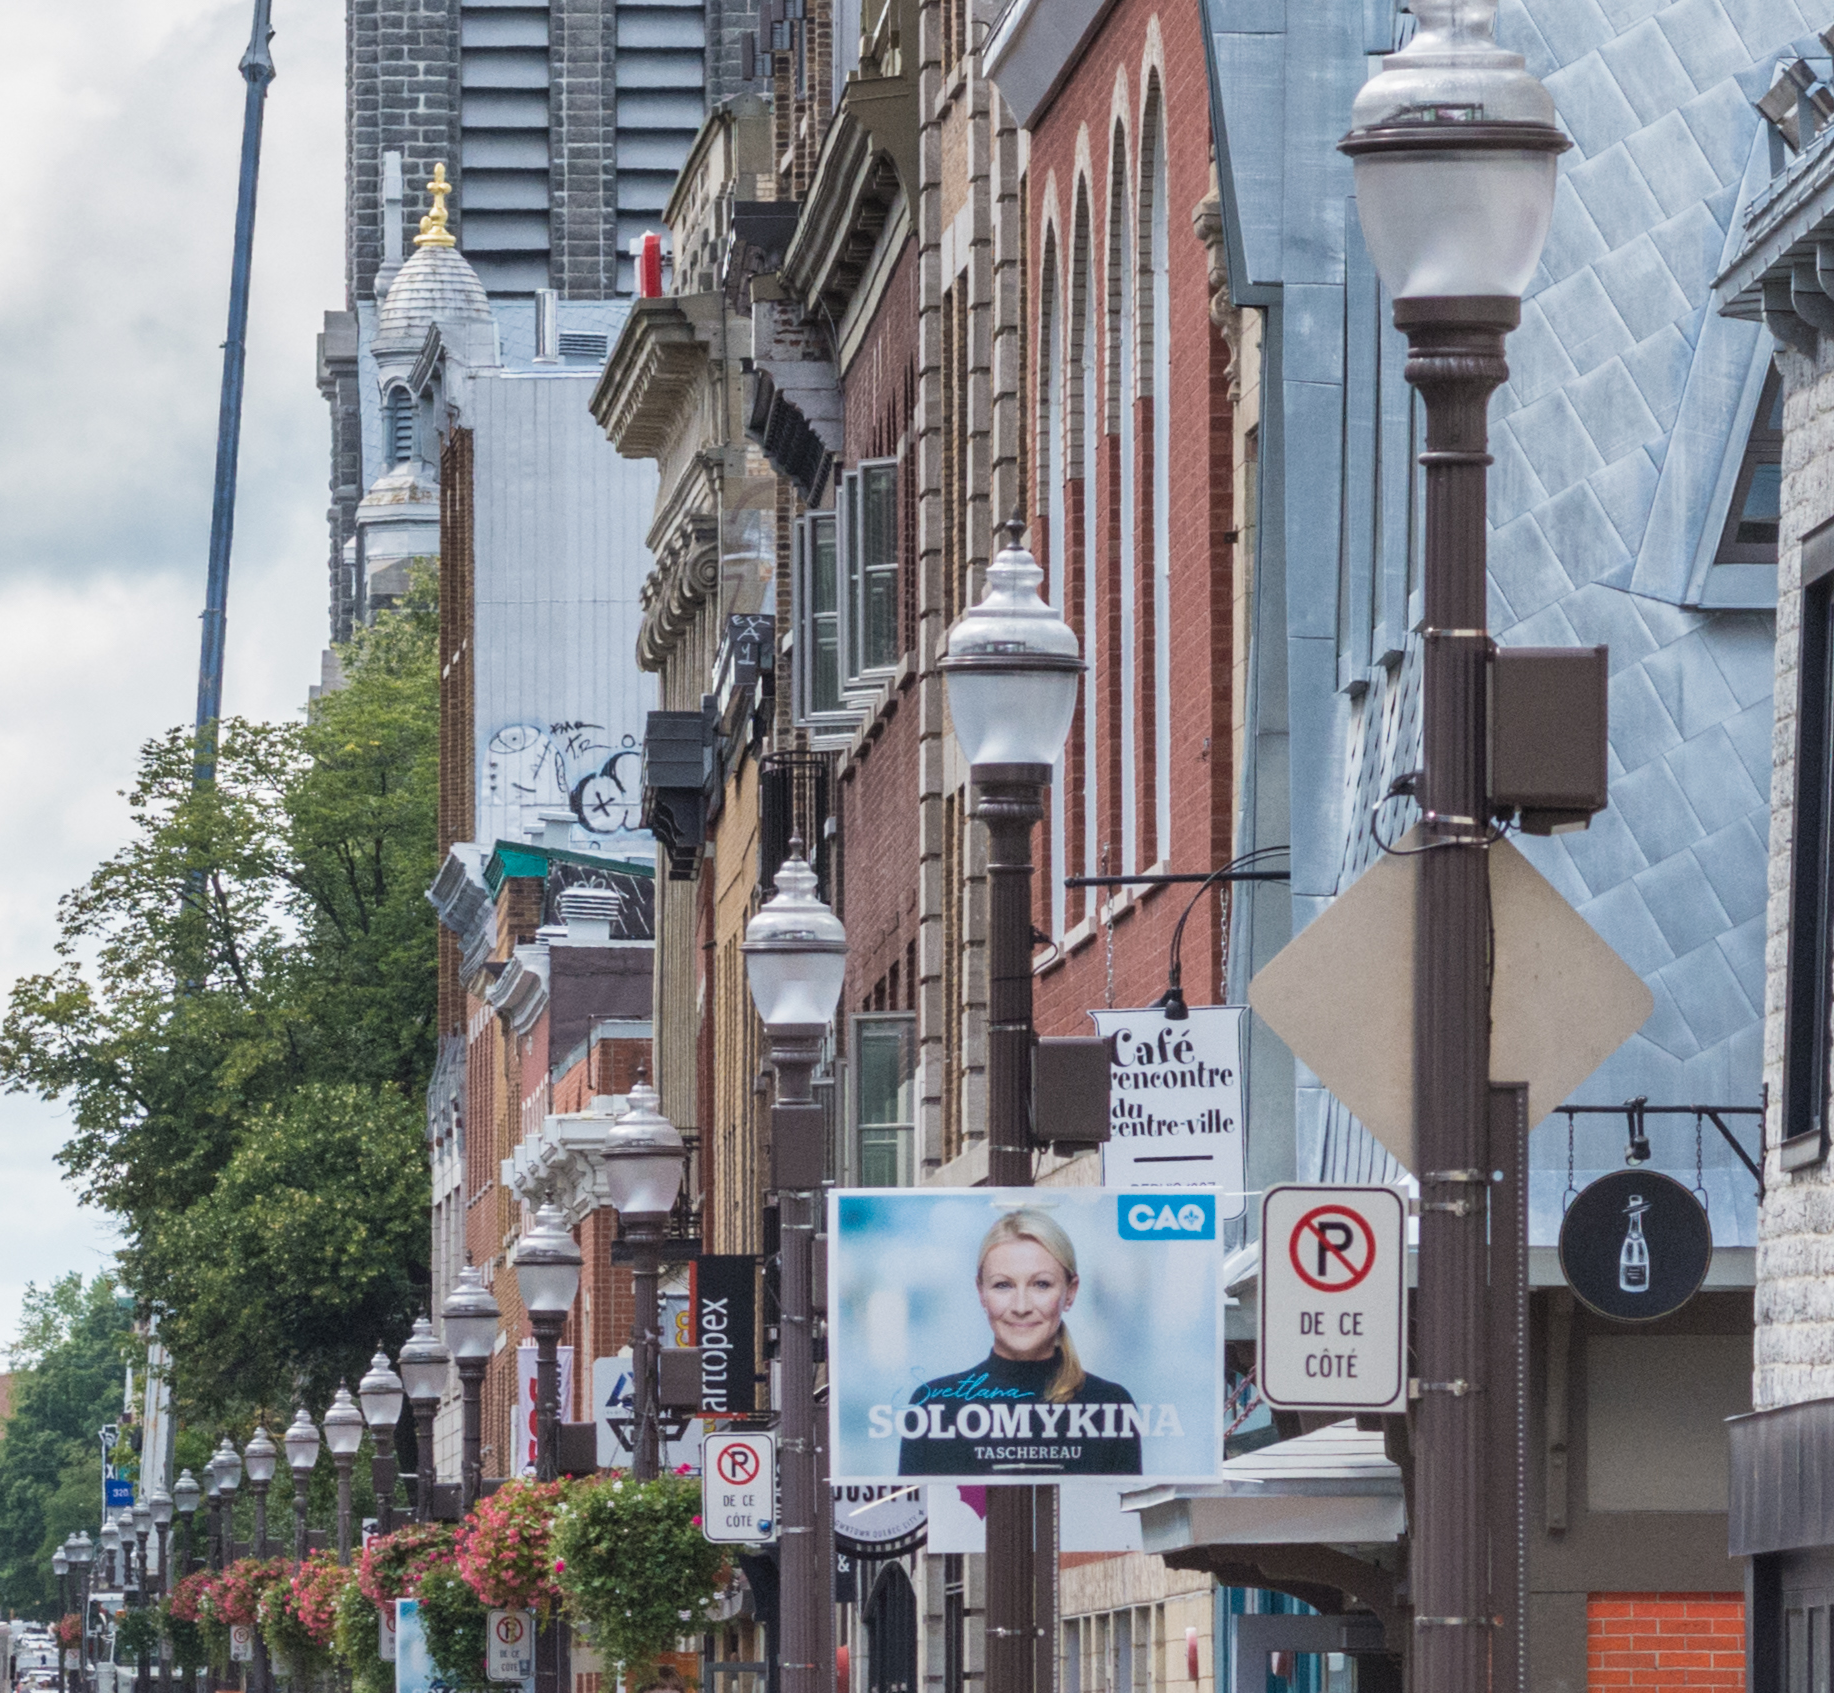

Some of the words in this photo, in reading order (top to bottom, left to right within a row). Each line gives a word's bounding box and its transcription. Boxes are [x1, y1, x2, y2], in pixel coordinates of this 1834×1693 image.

[1109, 1026, 1196, 1068] Café
[1111, 1061, 1235, 1091] rencontre
[1111, 1098, 1144, 1120] du
[1127, 1203, 1207, 1234] CAQ
[1300, 1311, 1326, 1336] DE
[1339, 1311, 1364, 1336] CE
[701, 1297, 734, 1412] artopex
[1305, 1347, 1359, 1378] CÔTÉ
[867, 1403, 1185, 1439] SOLOMYKINA
[974, 1446, 1083, 1460] TASCHEREAU
[723, 1495, 736, 1507] DE
[743, 1495, 755, 1507] CE
